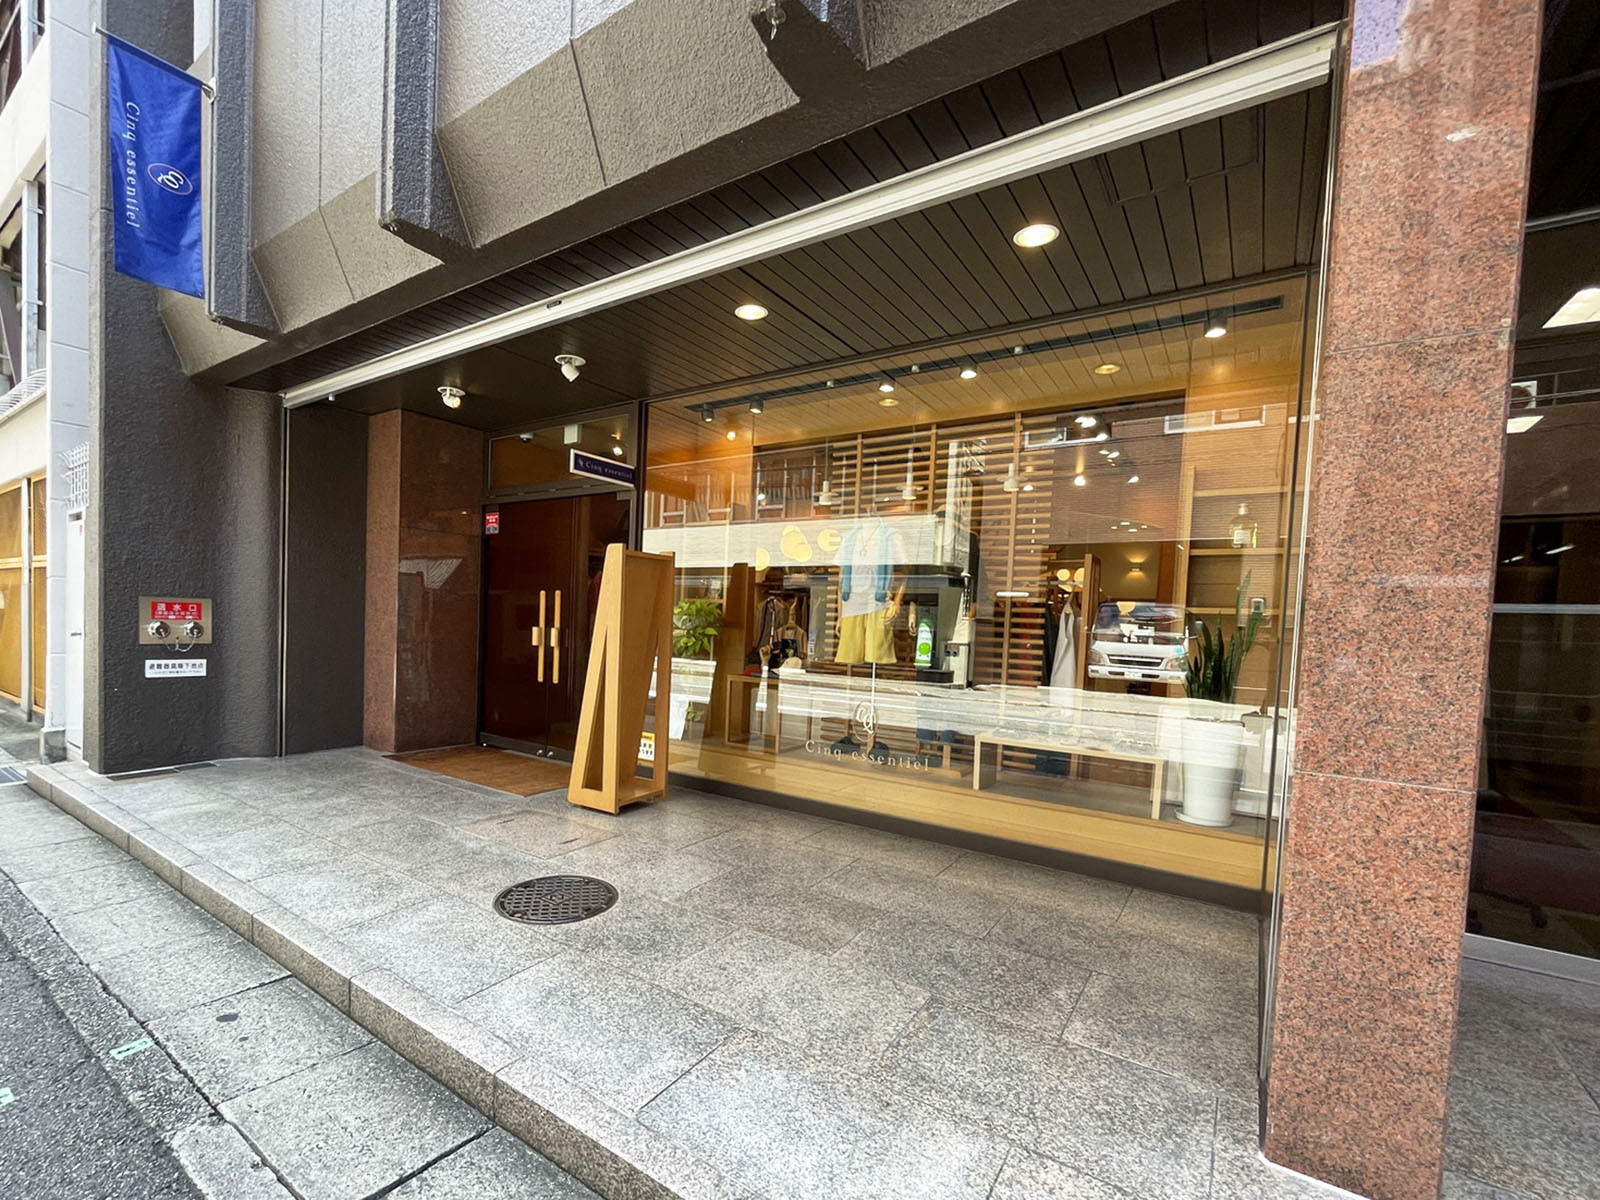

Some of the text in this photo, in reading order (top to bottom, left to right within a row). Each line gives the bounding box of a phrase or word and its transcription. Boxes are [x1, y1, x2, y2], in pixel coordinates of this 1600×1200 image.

[122, 101, 141, 229] Cinq essentiel
[805, 739, 929, 772] Cinq essentiel
